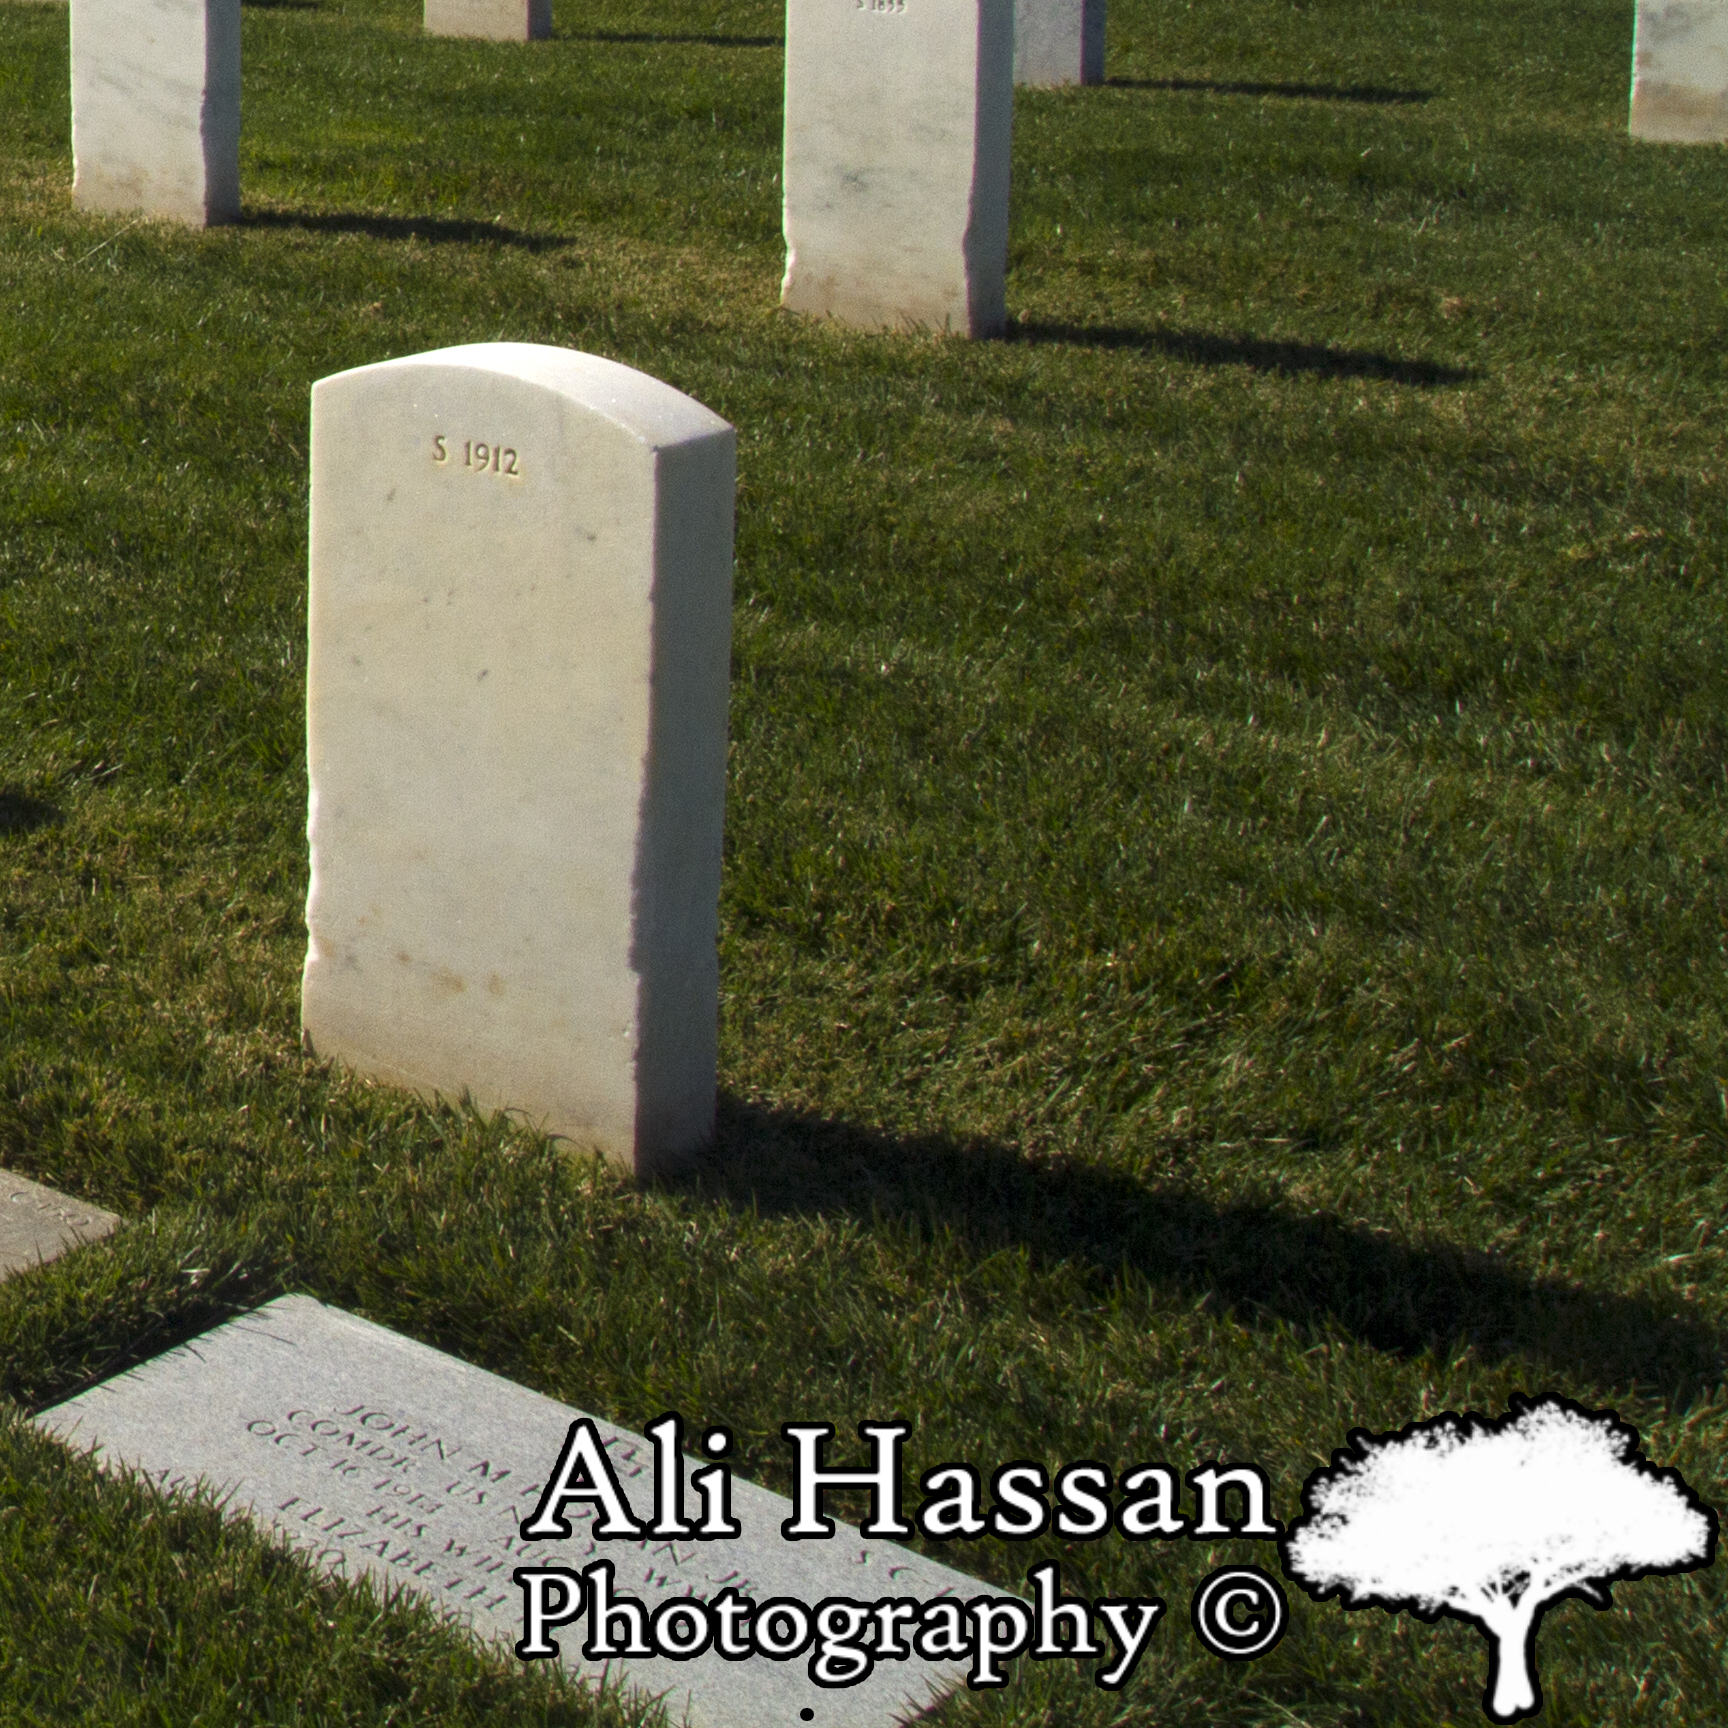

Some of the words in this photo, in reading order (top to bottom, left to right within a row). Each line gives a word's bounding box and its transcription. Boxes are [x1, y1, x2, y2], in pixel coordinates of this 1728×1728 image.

[433, 435, 446, 463] S
[464, 440, 520, 476] 1912
[240, 1418, 331, 1461] OCT
[332, 1400, 462, 1460] JOHN
[281, 1407, 425, 1475] COMDR
[439, 1480, 494, 1507] US
[364, 1505, 434, 1539] HIS
[273, 1496, 509, 1613] ELIZABETH
